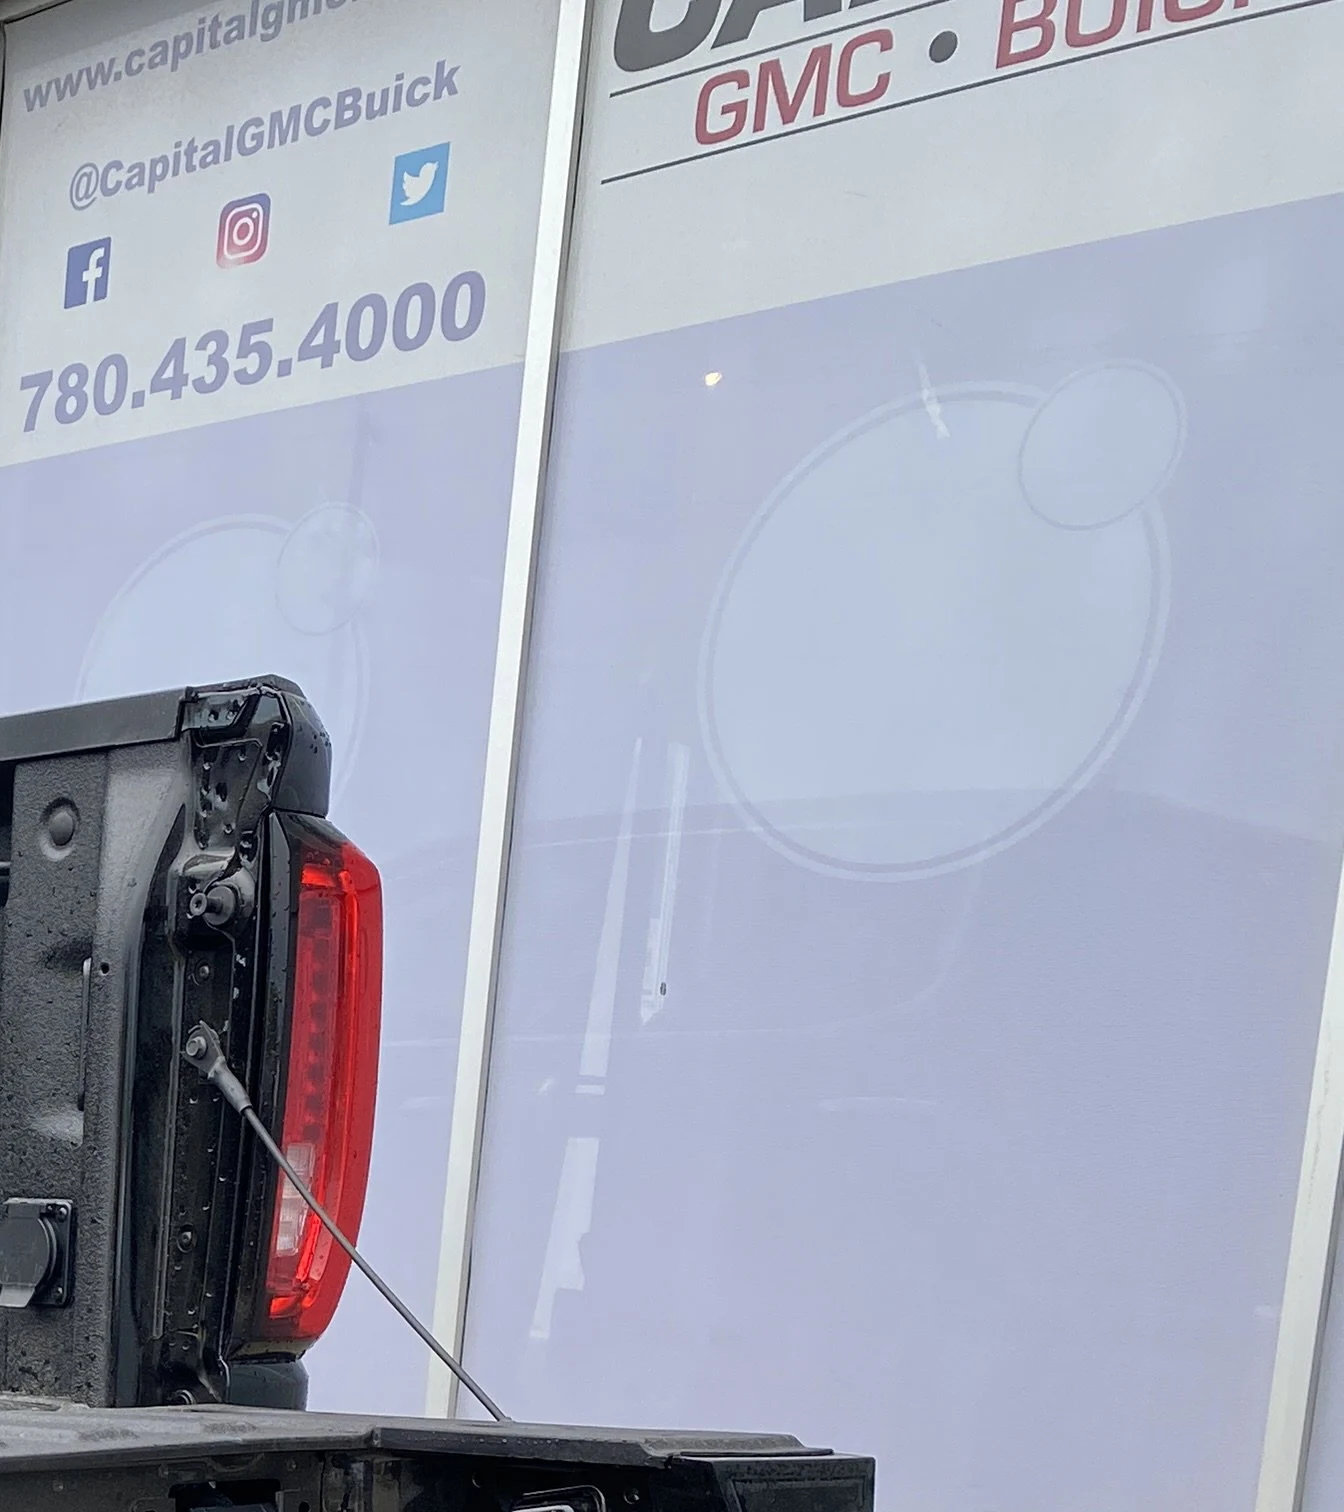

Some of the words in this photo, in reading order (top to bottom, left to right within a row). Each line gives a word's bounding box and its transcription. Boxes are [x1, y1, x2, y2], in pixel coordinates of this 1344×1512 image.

[22, 0, 358, 113] www.capitalgm
[695, 28, 894, 146] GMC
[69, 59, 462, 211] @CapitalGMCBuick
[19, 270, 487, 433] 780.435.4000
